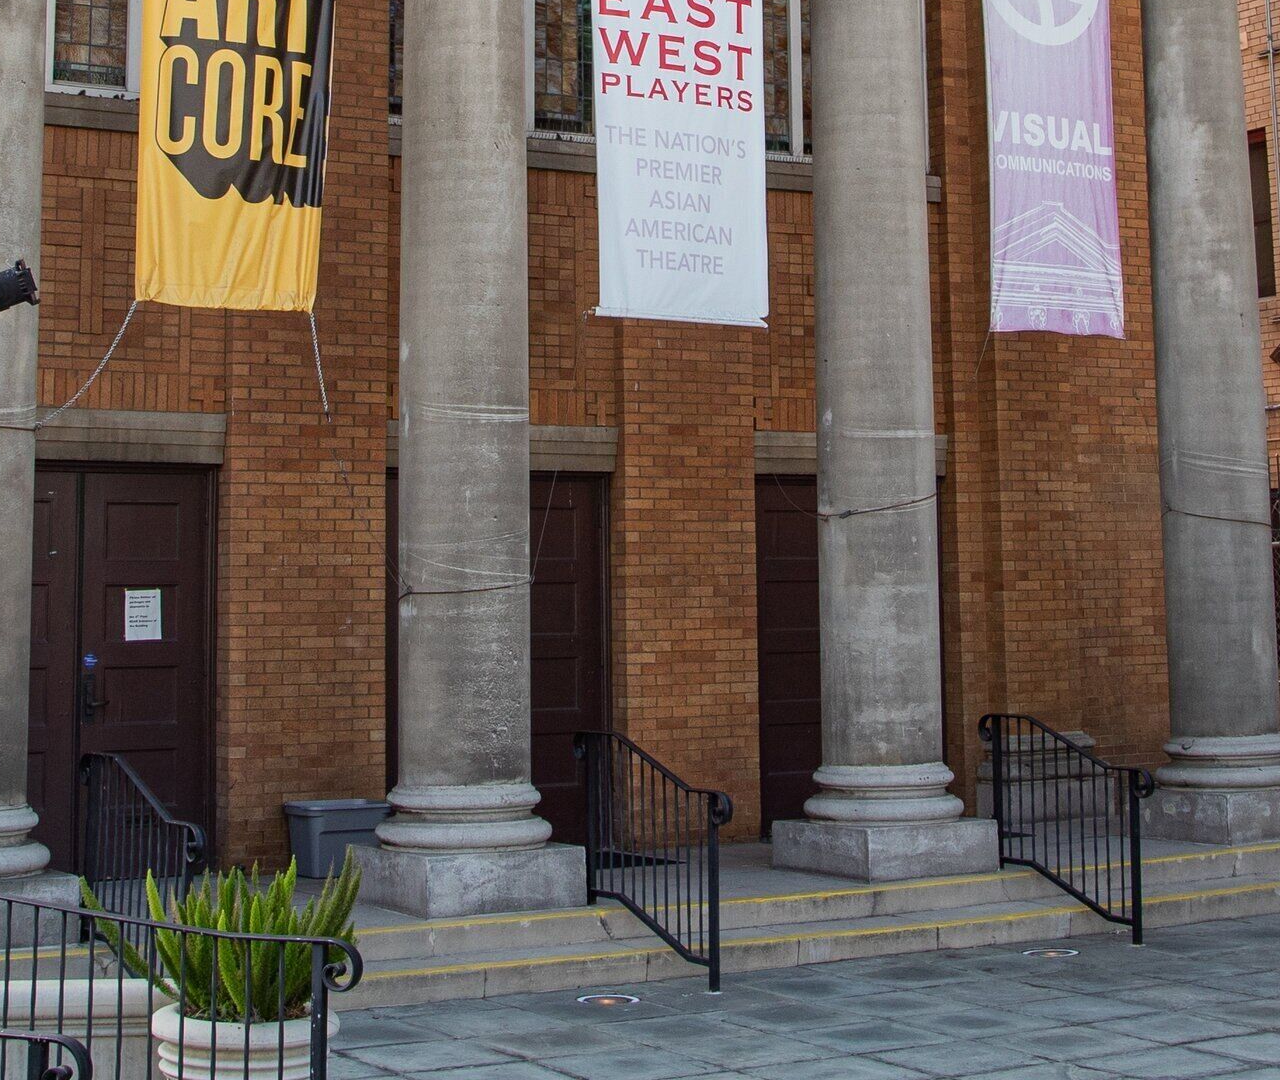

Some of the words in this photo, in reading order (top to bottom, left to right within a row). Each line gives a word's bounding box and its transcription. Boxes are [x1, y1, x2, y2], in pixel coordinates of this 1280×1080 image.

[599, 26, 753, 81] WEST
[156, 44, 312, 168] CORE
[601, 72, 754, 112] PLAYERS
[604, 124, 647, 147] THE
[654, 129, 747, 160] NATION'S
[636, 157, 723, 186] PREMIER
[992, 153, 1113, 182] OMMUNICATIONS
[649, 189, 711, 214] ASIAN
[624, 218, 733, 247] AMERICAN
[636, 249, 724, 275] THEATRE
